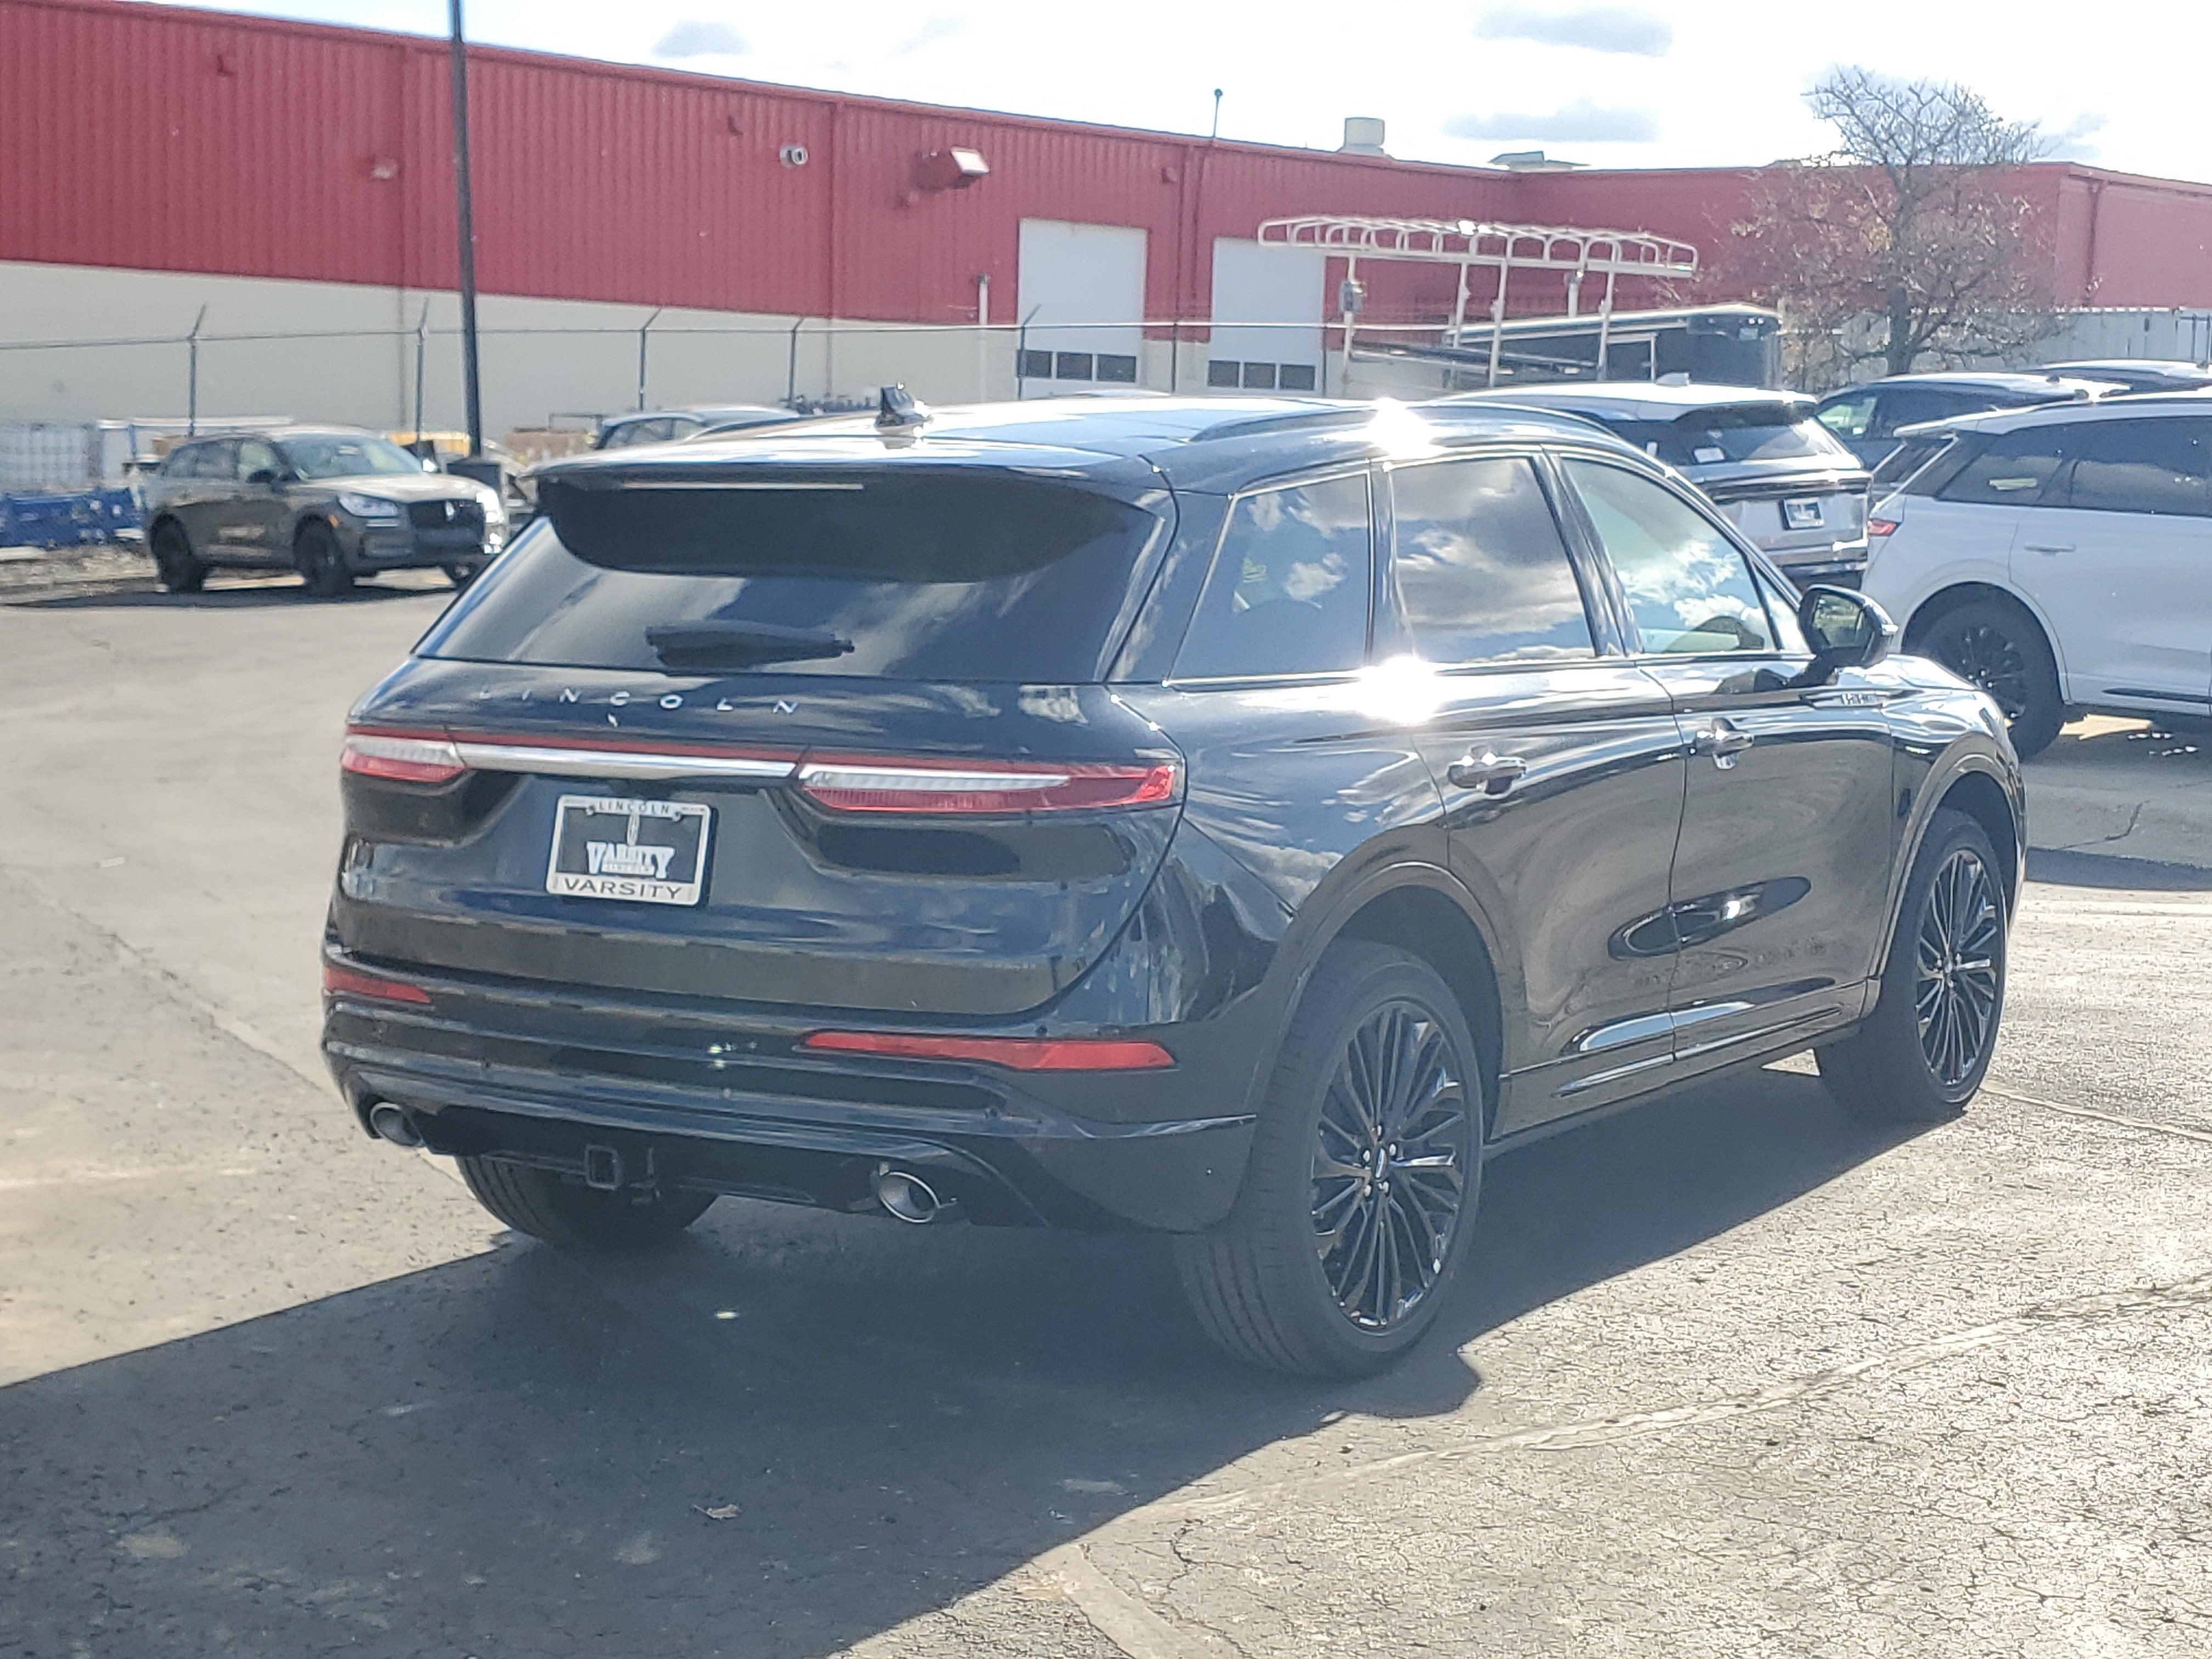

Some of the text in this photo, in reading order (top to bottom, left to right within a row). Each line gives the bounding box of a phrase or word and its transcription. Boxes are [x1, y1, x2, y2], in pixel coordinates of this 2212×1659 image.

[478, 687, 799, 714] LINCOLN
[599, 800, 669, 814] LINCOLN
[565, 878, 681, 900] VARSITY
